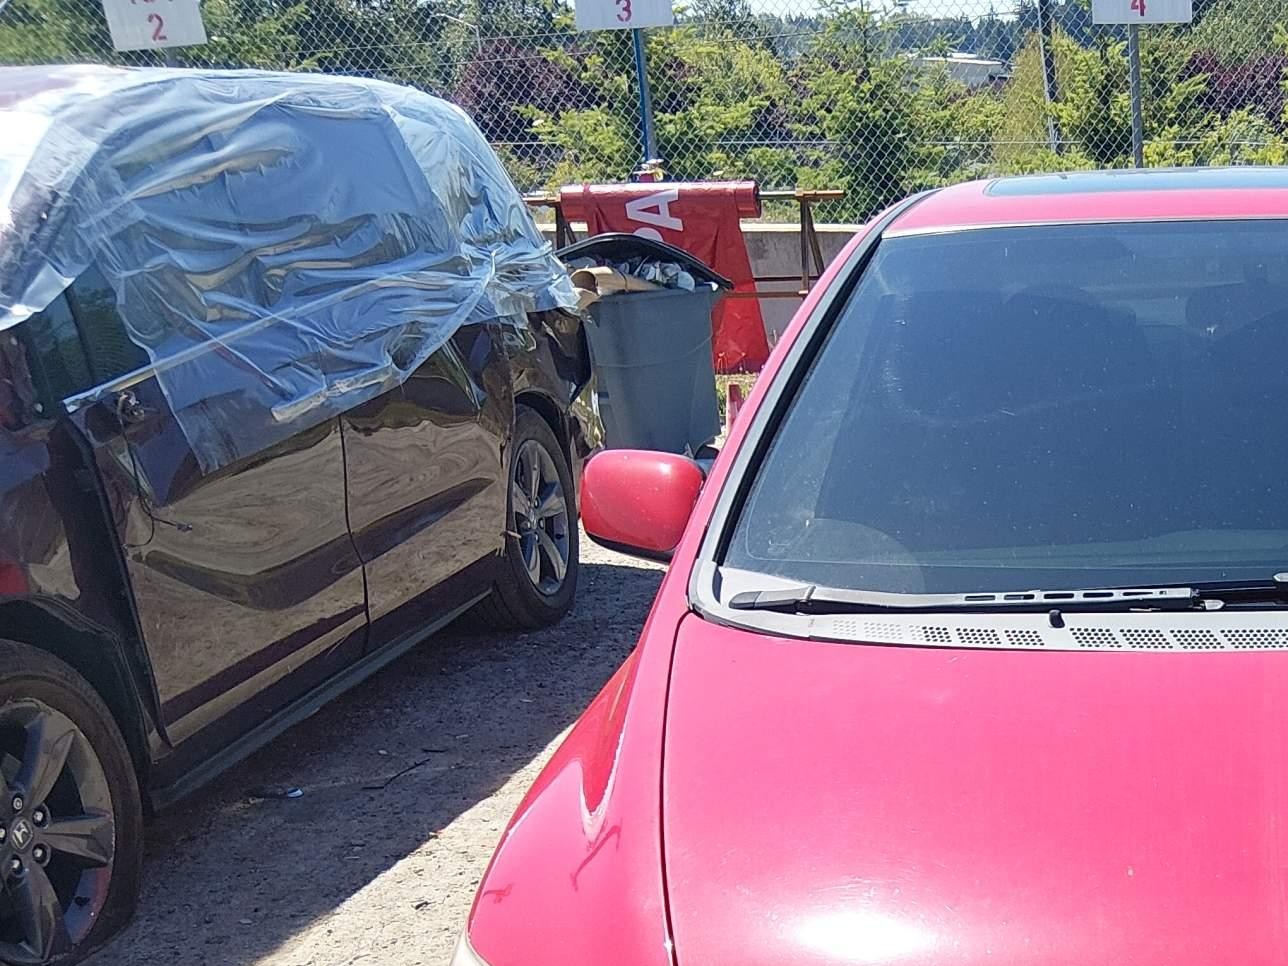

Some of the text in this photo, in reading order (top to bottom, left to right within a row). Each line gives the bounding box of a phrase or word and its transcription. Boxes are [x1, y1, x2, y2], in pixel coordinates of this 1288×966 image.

[616, 0, 632, 22] 3
[1130, 0, 1146, 17] 4
[147, 13, 167, 41] 2
